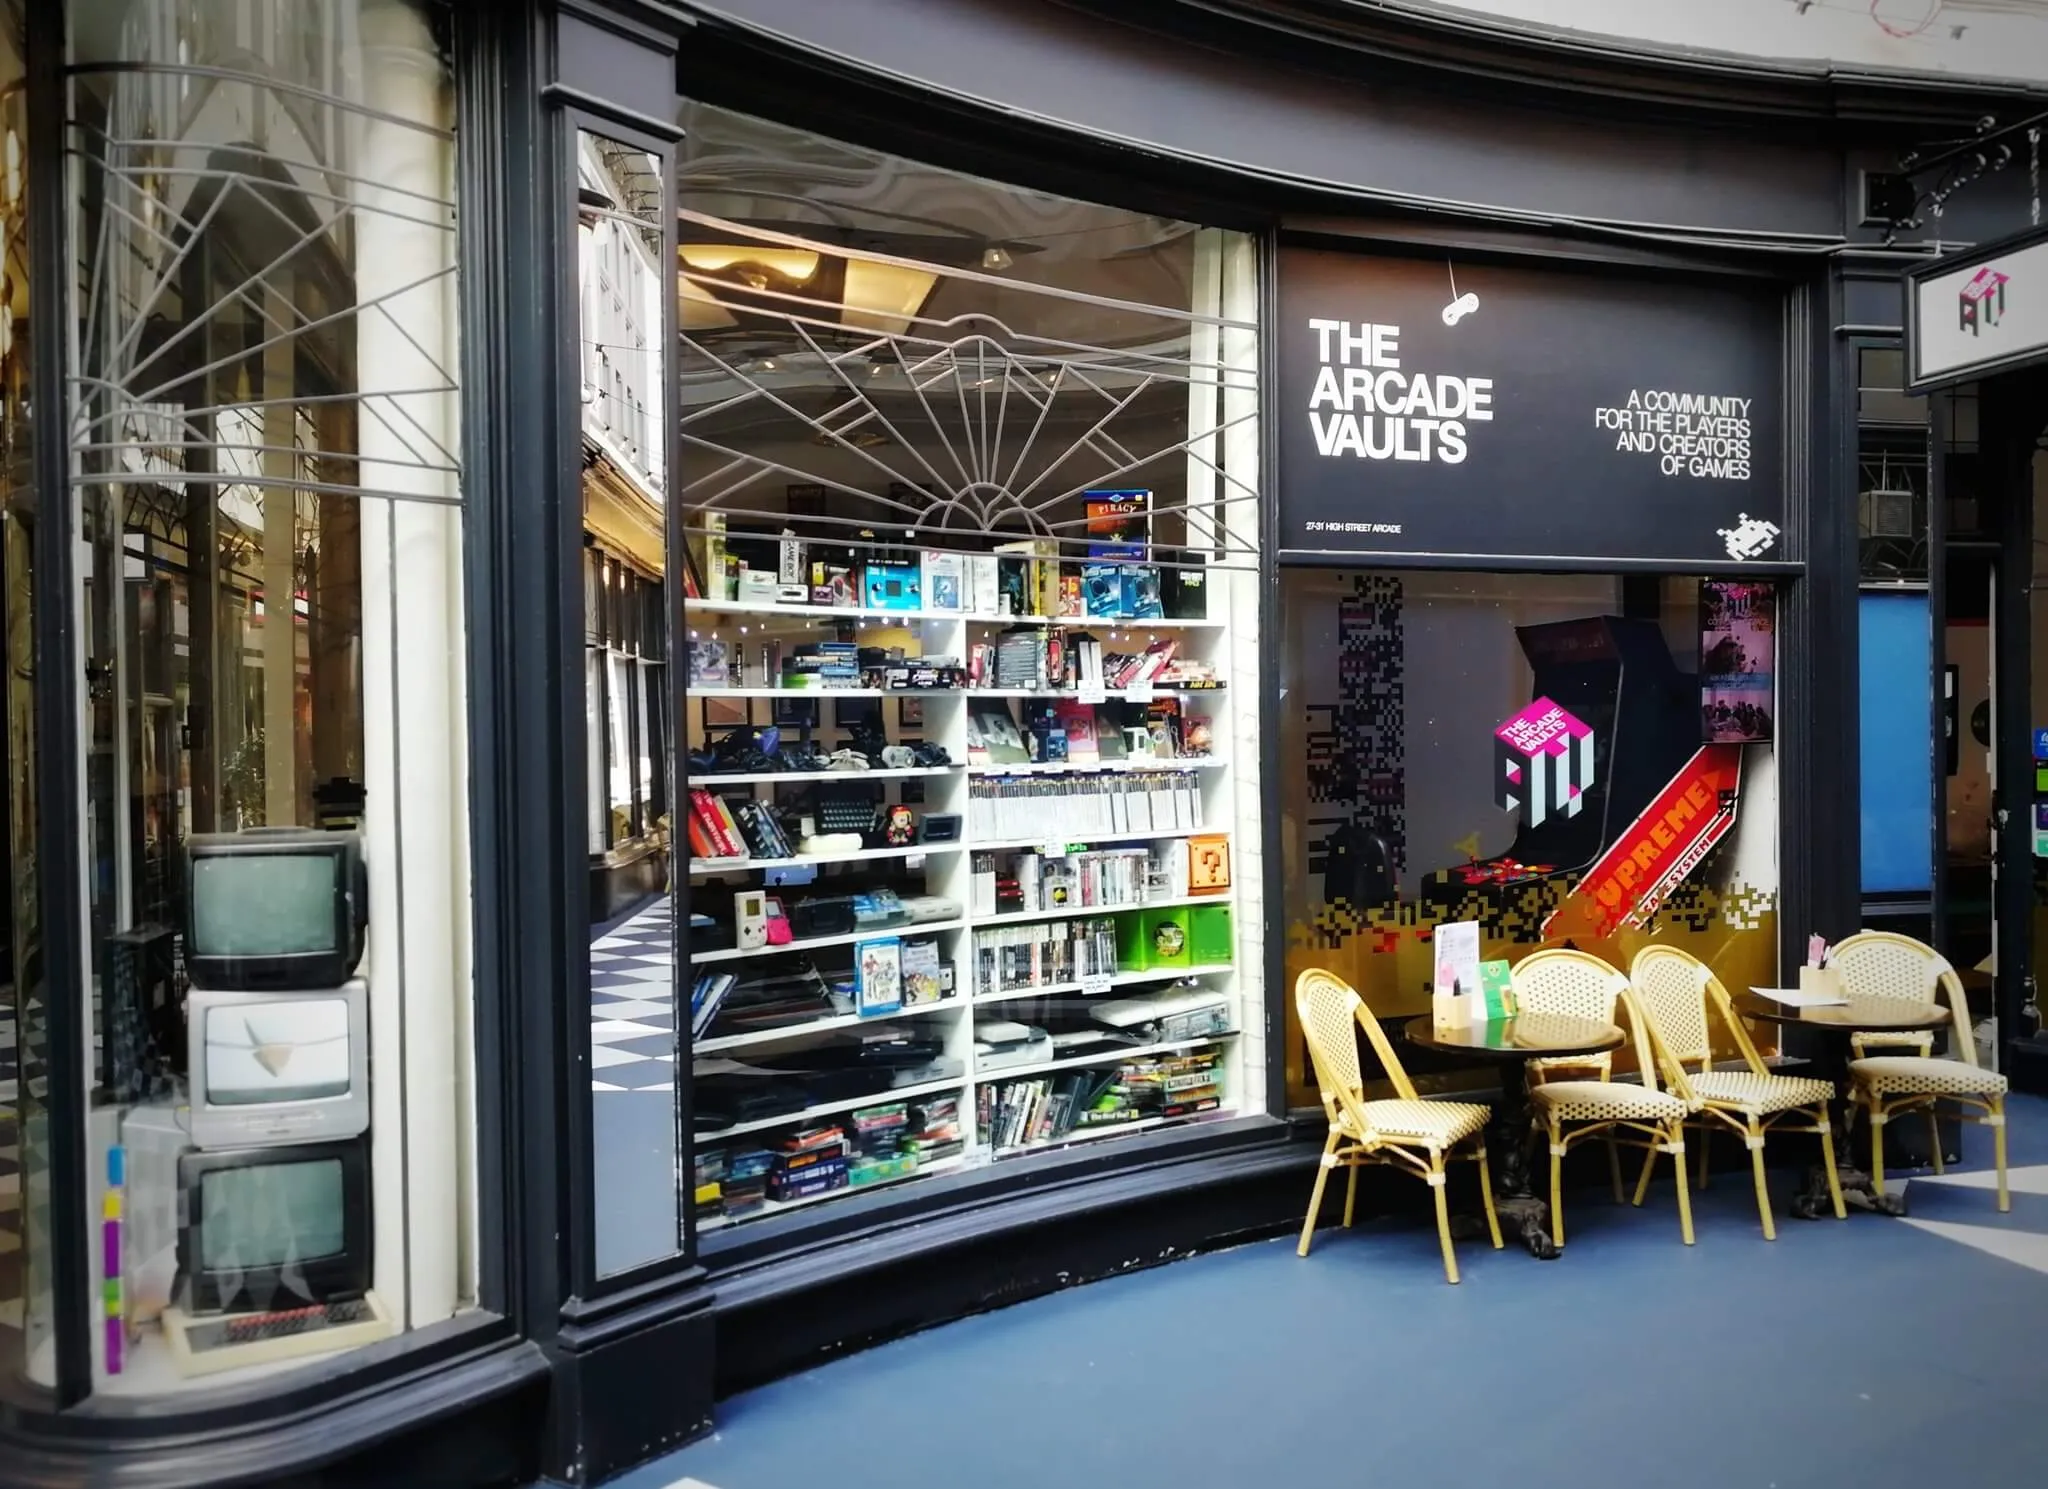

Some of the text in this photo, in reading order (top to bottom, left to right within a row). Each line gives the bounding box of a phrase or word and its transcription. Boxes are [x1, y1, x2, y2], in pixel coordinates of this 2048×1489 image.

[1309, 318, 1400, 368] THE
[1309, 366, 1493, 421] ARCADE
[1627, 389, 1751, 418] A COMMUNITY
[1309, 412, 1467, 464] VAULTS
[1596, 408, 1751, 439] FOR THE PLAYERS
[1616, 431, 1751, 460] AND CREATORS
[1661, 455, 1751, 481] OF GAMES
[1098, 503, 1137, 514] PIRACY
[1305, 521, 1401, 534] 27-31 HIGH STREET ARCADE
[1500, 718, 1531, 738] THE
[1513, 707, 1564, 746] ARCADE
[1520, 719, 1567, 752] VAULTS
[1669, 838, 1711, 885] SYSTEM
